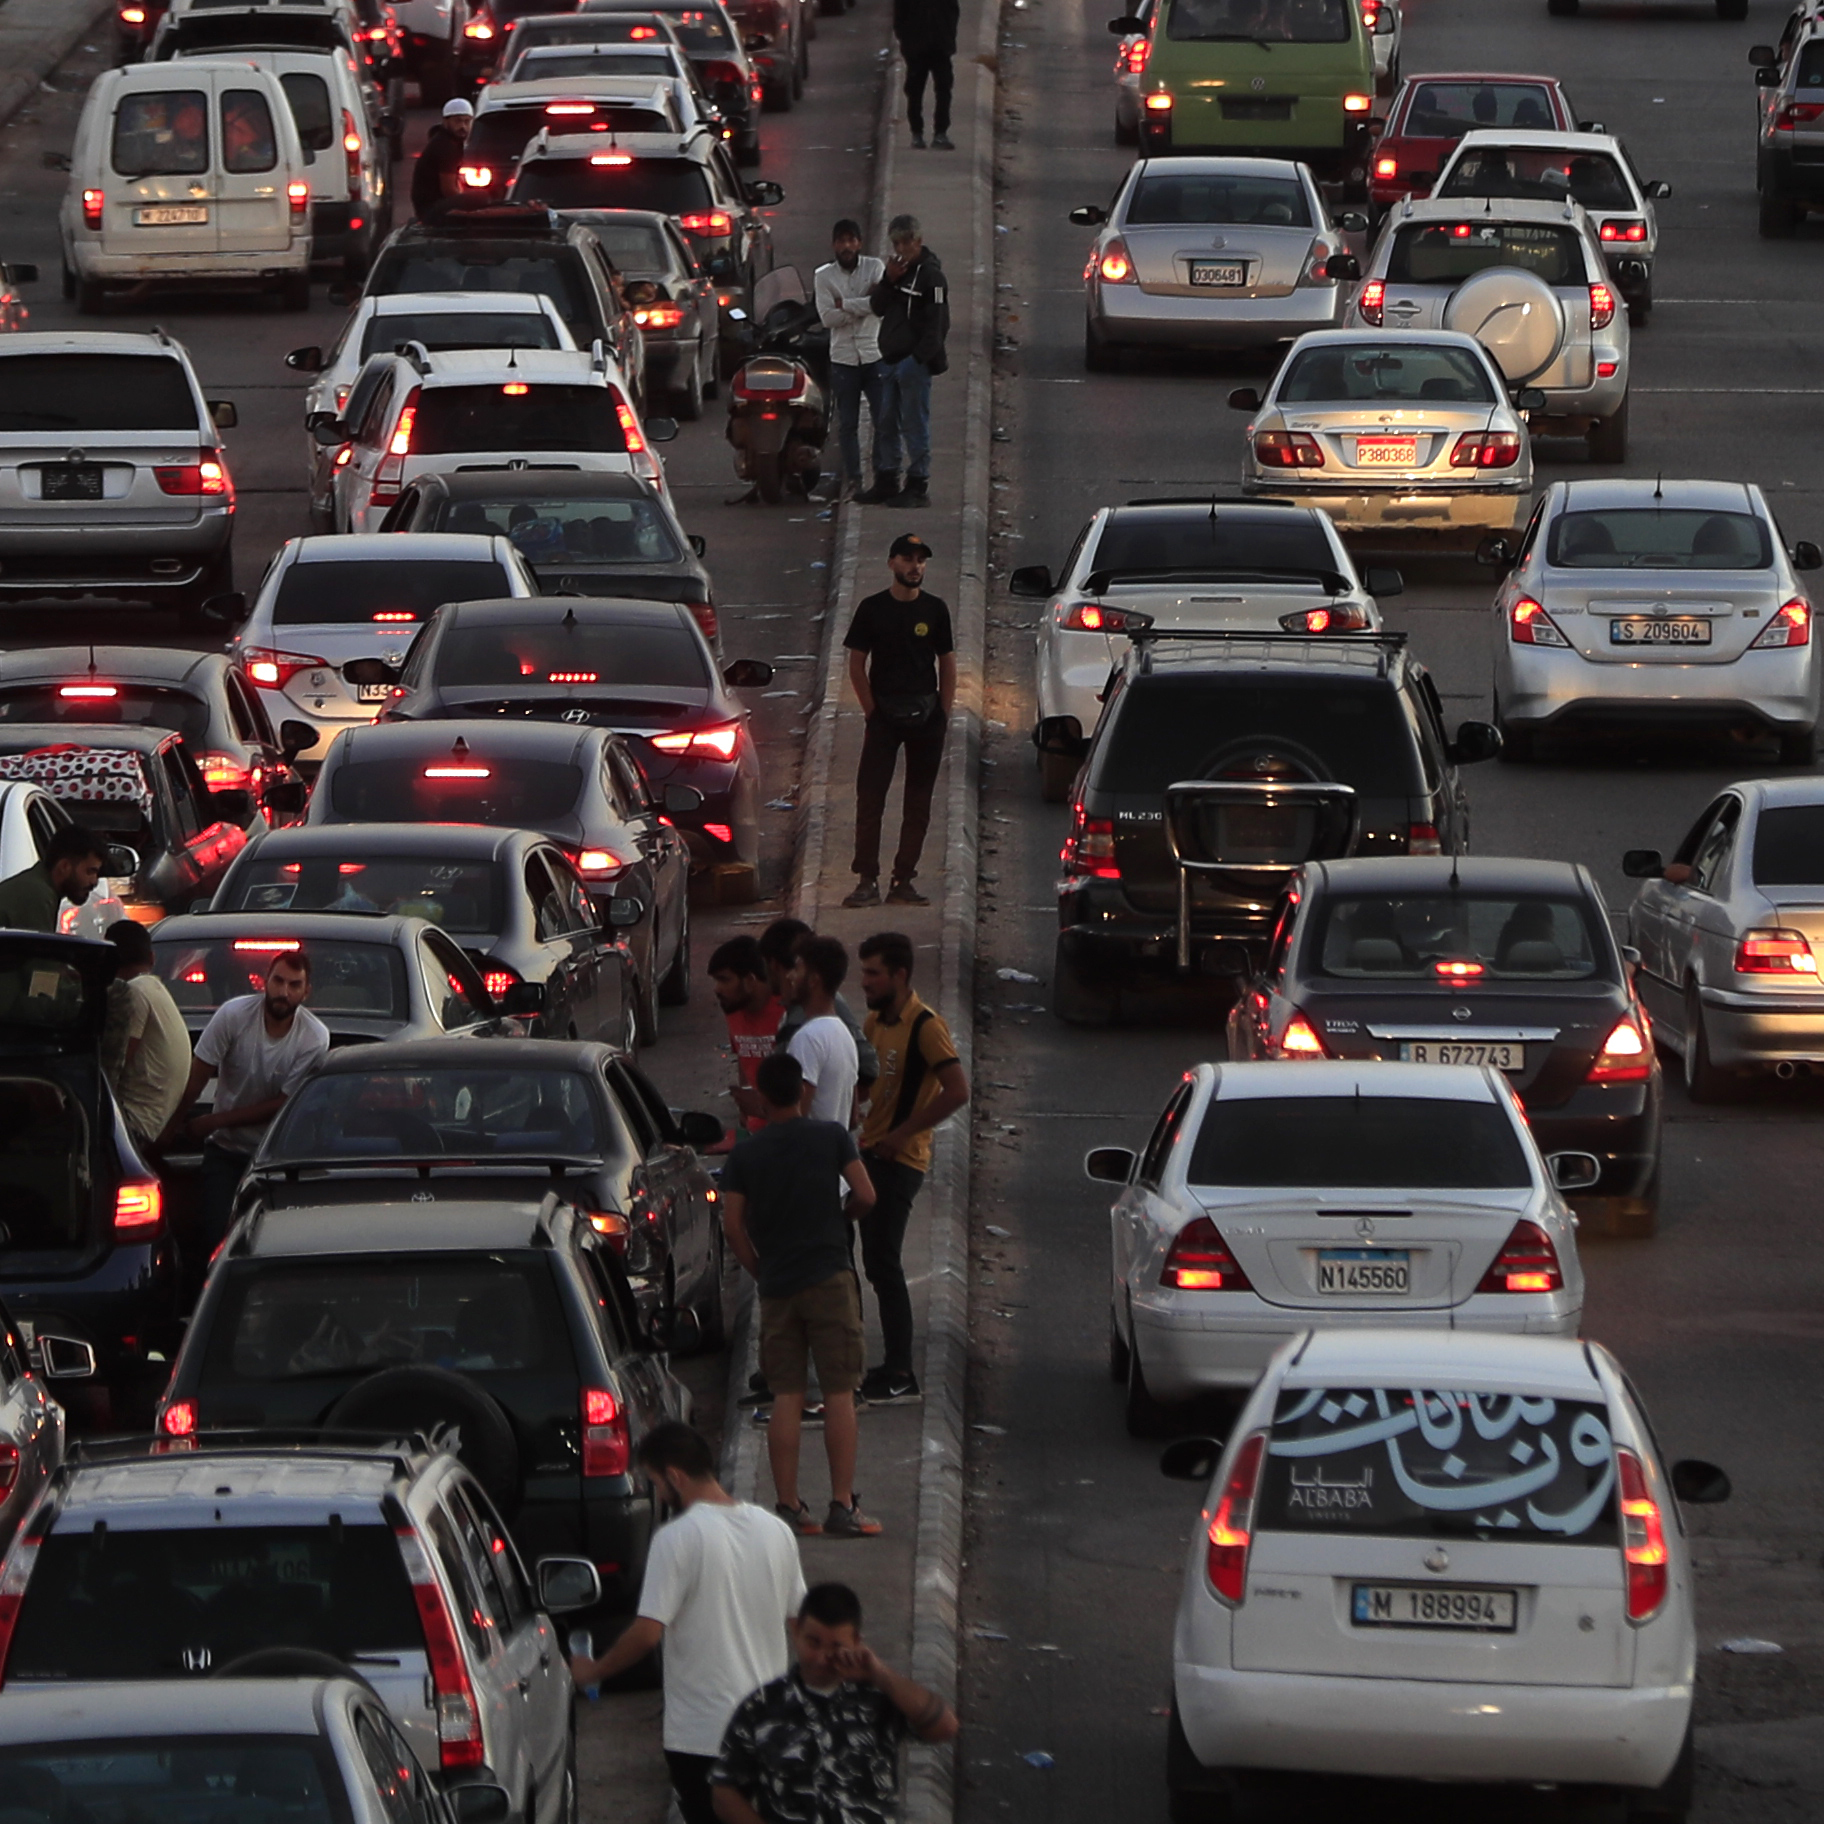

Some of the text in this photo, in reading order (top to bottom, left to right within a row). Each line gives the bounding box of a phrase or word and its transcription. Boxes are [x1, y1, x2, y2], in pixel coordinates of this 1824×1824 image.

[1358, 447, 1416, 463] P380368
[1625, 623, 1699, 639] S 209604
[1438, 1046, 1510, 1066] 672743
[1321, 1266, 1407, 1289] N145560
[1289, 1488, 1373, 1509] ALBABA
[1374, 1594, 1495, 1623] M 188994
